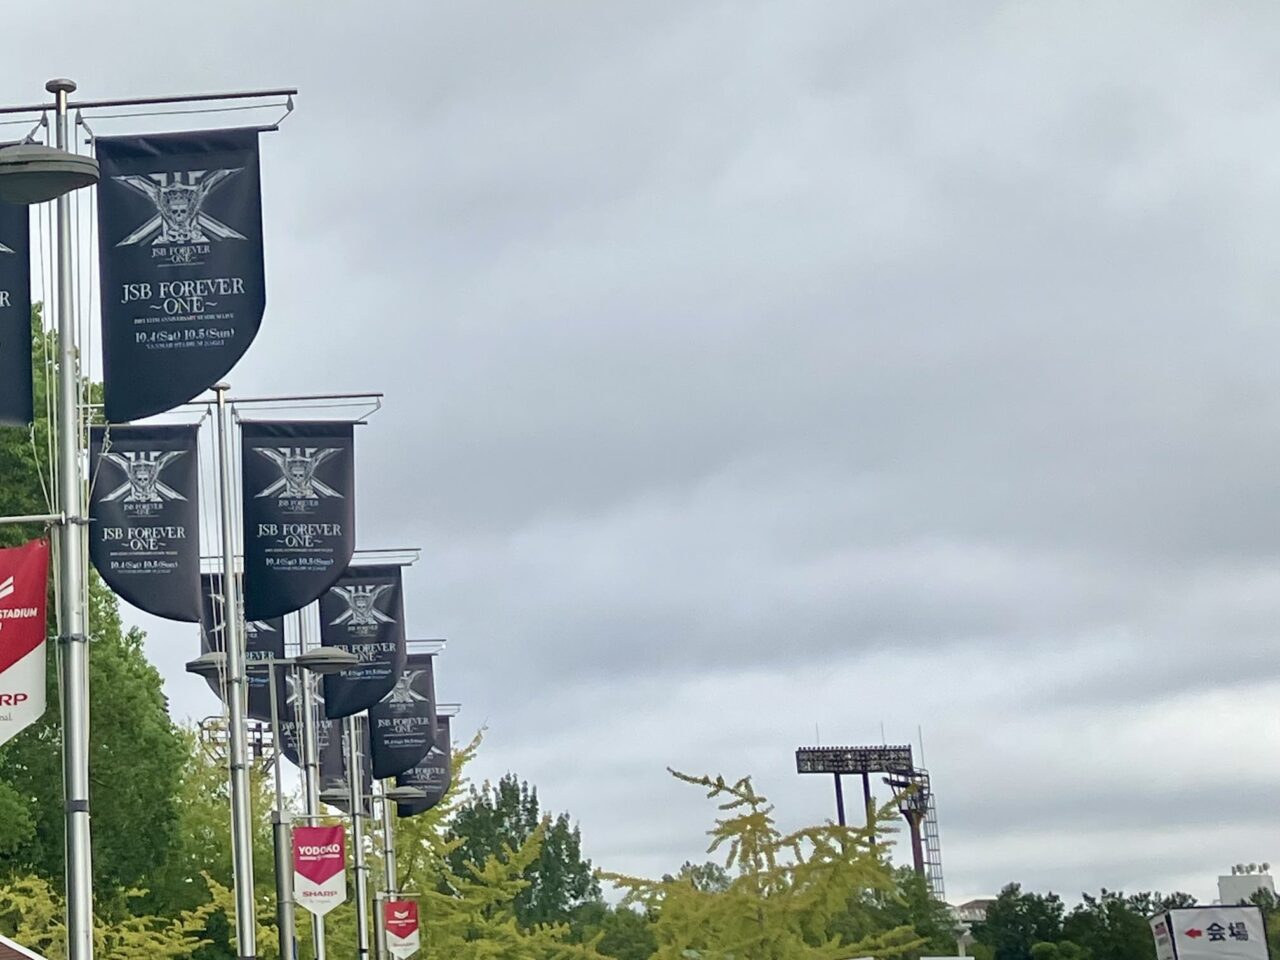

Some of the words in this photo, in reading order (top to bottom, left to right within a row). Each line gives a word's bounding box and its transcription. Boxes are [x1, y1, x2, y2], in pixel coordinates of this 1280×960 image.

[121, 283, 152, 304] JSB
[158, 278, 245, 299] FOREVER
[102, 527, 123, 542] JSB
[127, 526, 186, 540] FOREVER
[257, 524, 278, 538] JSB
[282, 523, 342, 536] FOREVER
[298, 844, 341, 856] YODOKO
[302, 890, 338, 898] SHARP
[1206, 921, 1249, 942] 会場
